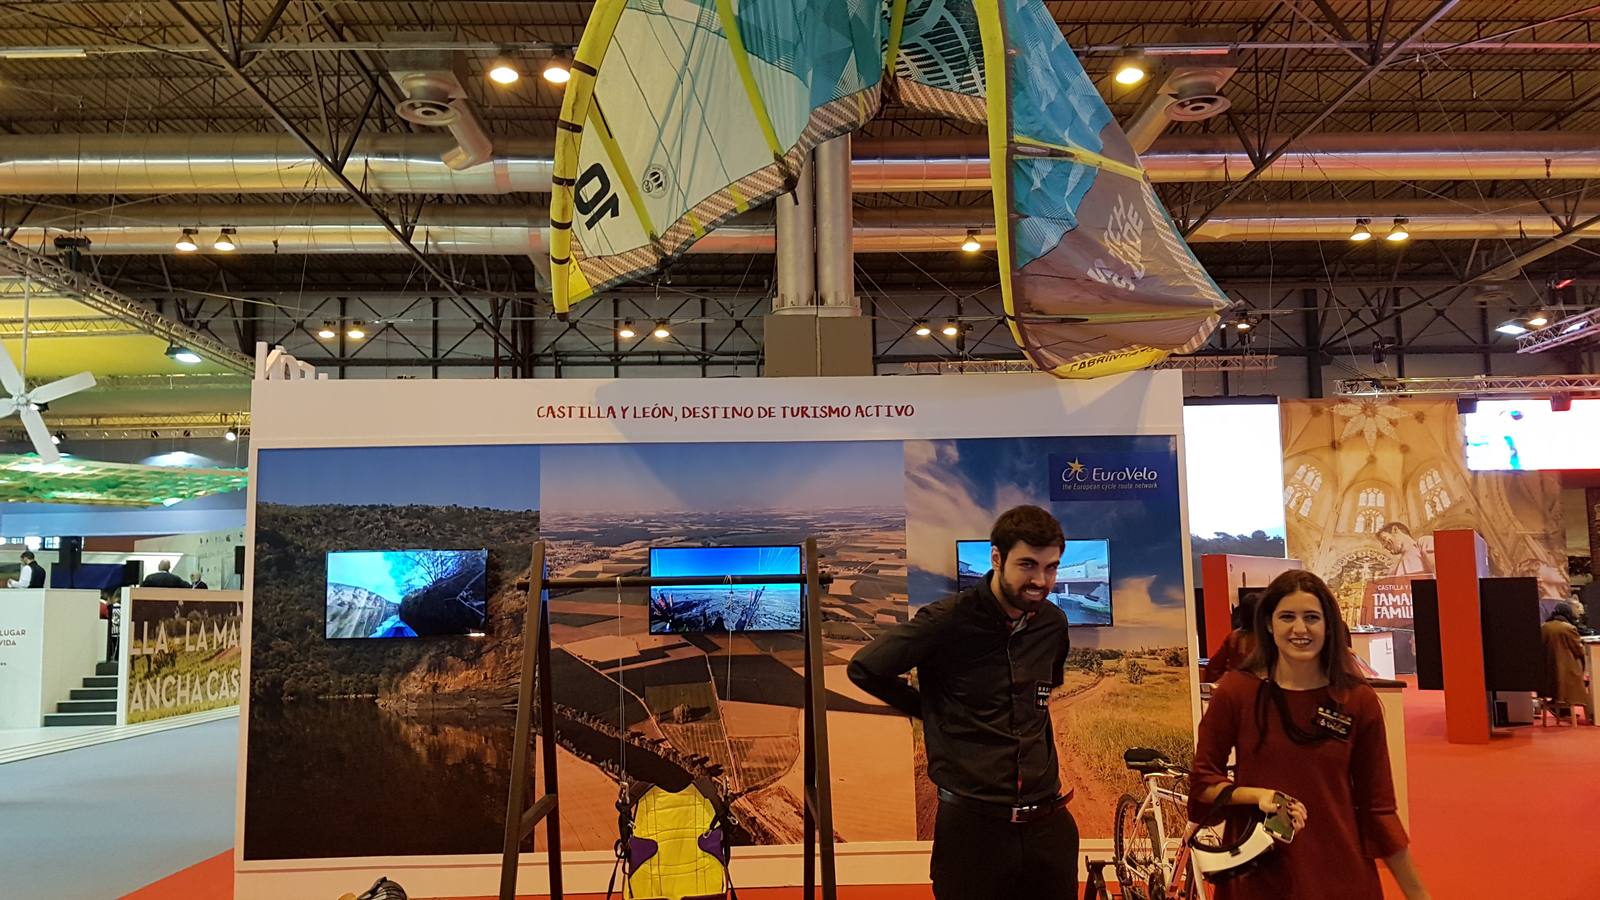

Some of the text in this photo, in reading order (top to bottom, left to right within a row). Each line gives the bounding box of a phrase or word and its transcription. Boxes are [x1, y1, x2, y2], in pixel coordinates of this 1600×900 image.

[536, 402, 916, 422] CASTILLA Y LEÓN, DESTINO DE TURISMO ACTIVO
[1092, 466, 1158, 481] EuroVelo
[1062, 481, 1158, 491] the European cycle route network
[212, 620, 242, 650] MA
[129, 667, 240, 714] ANCHA CAS
